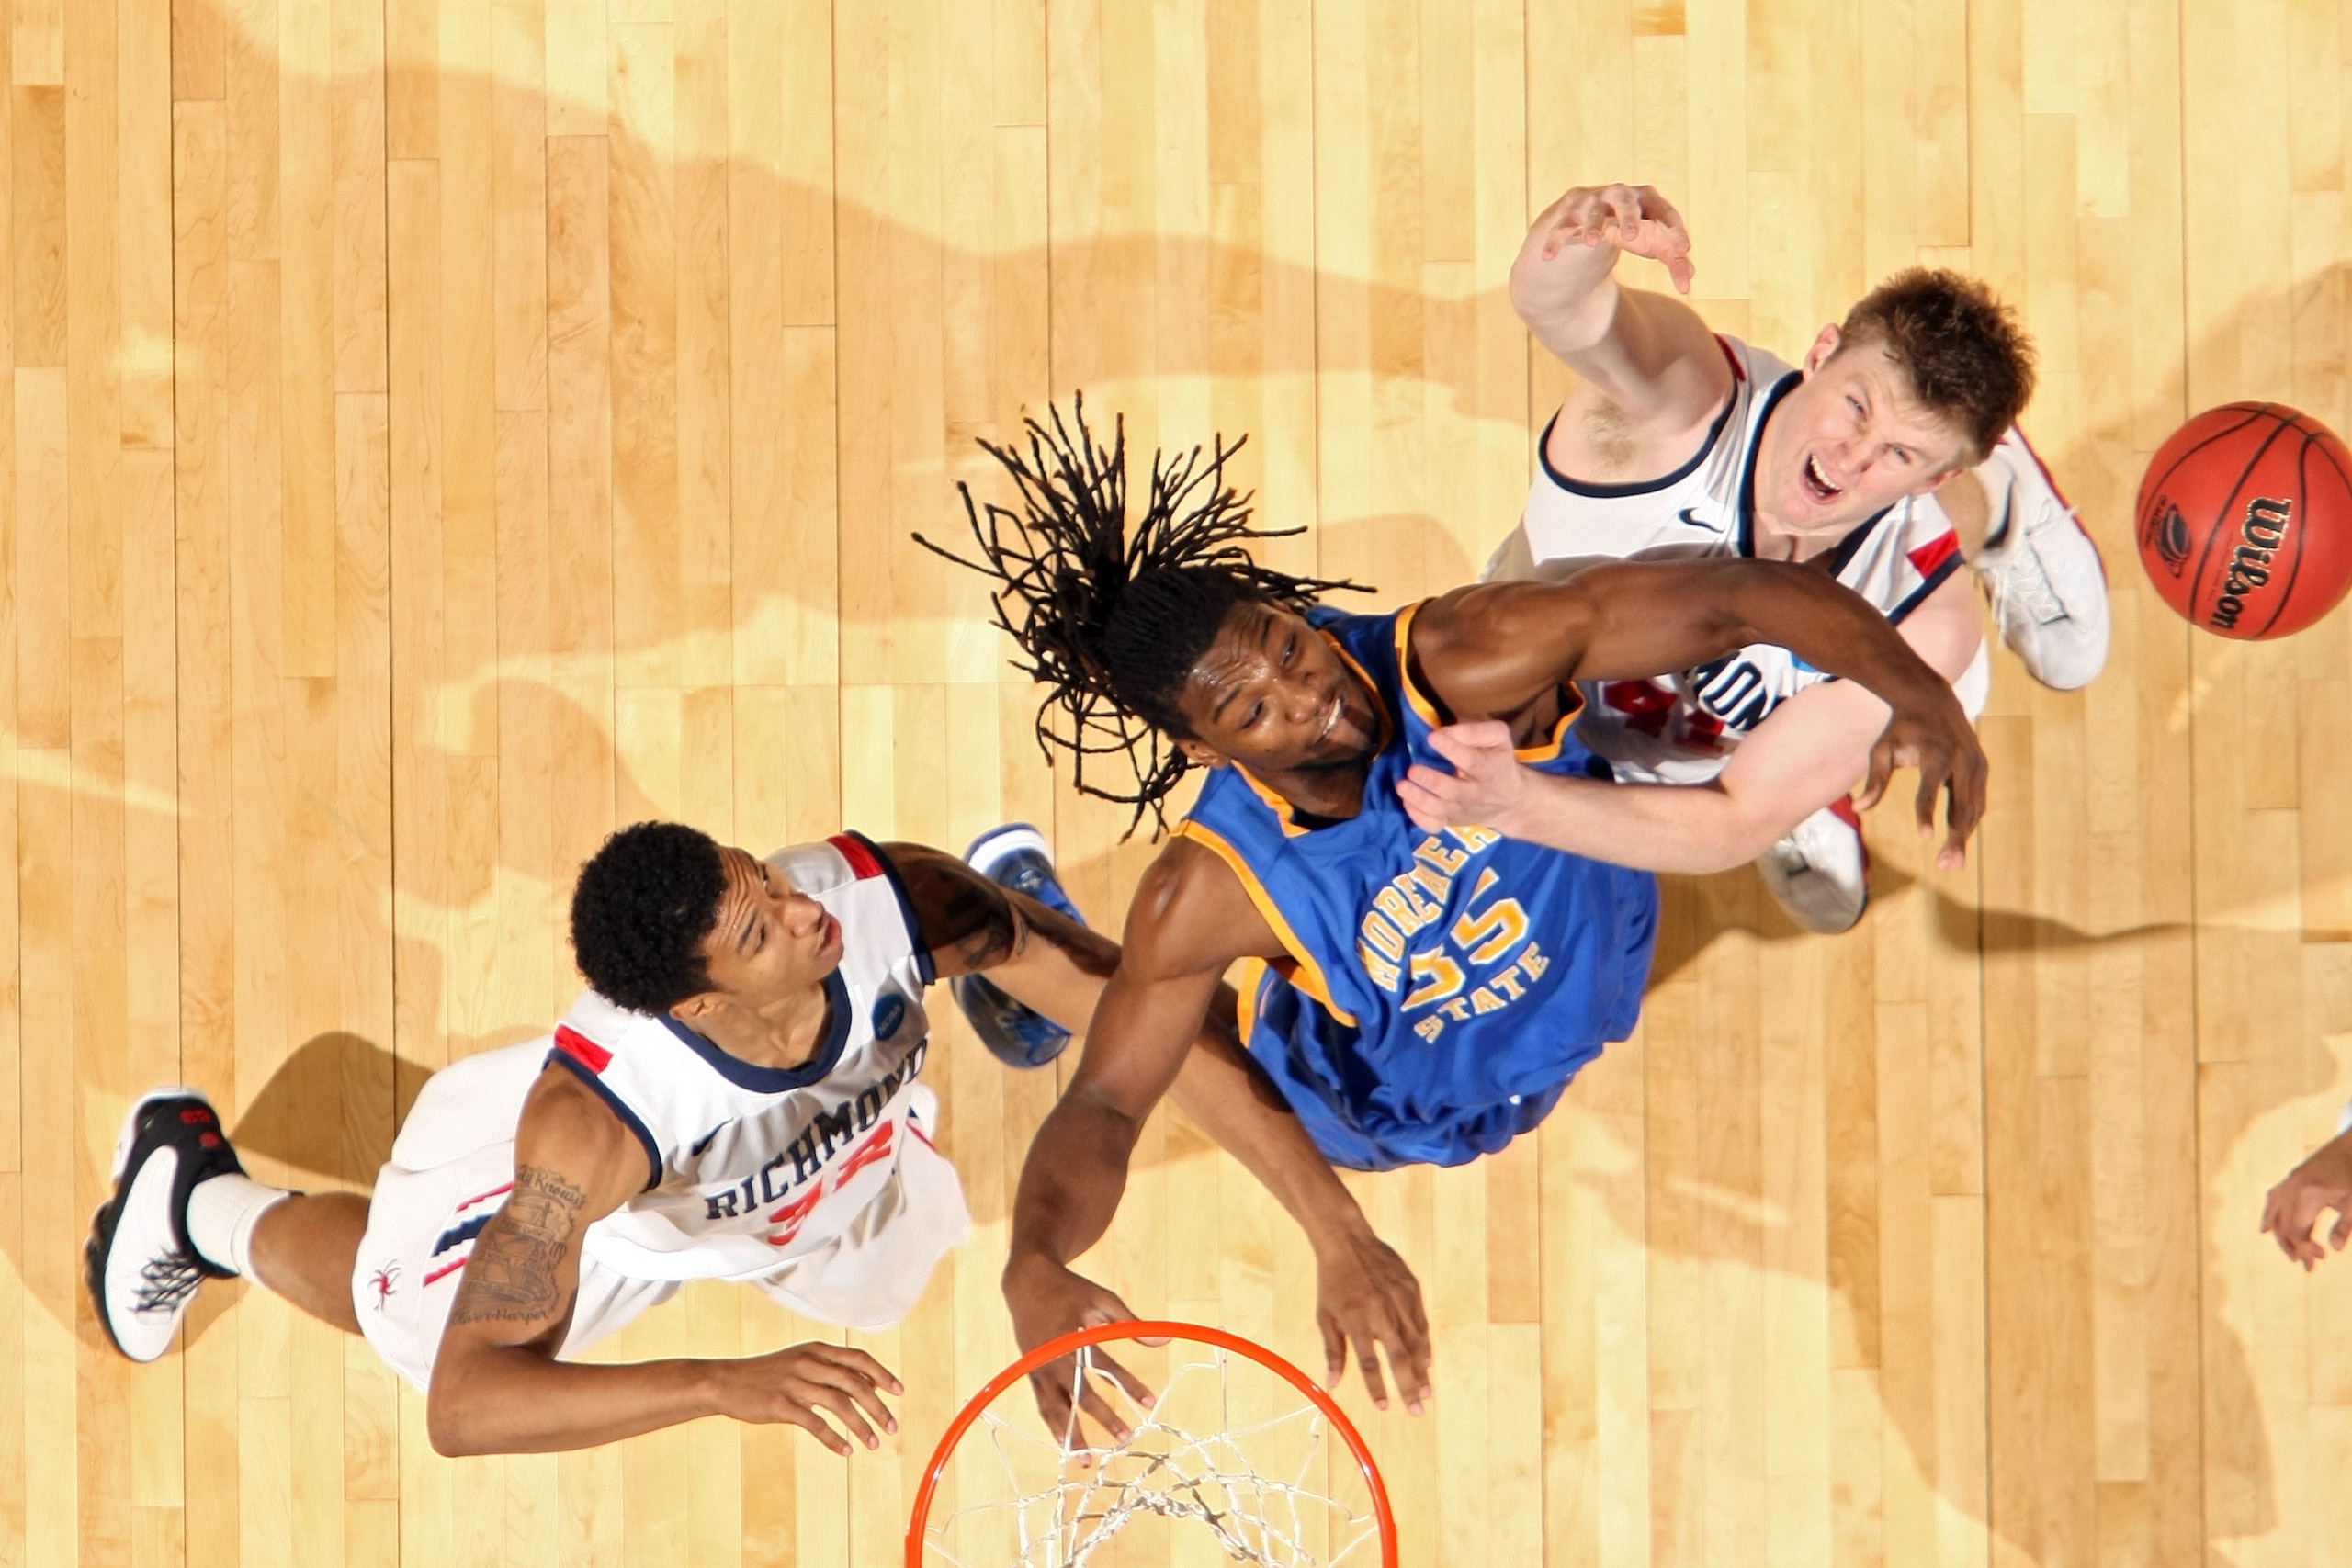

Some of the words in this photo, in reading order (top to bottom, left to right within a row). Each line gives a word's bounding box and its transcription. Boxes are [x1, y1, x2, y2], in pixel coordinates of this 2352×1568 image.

[2209, 496, 2293, 630] Wilson
[1413, 941, 1551, 1045] STATE
[704, 1035, 930, 1221] RICHMOND
